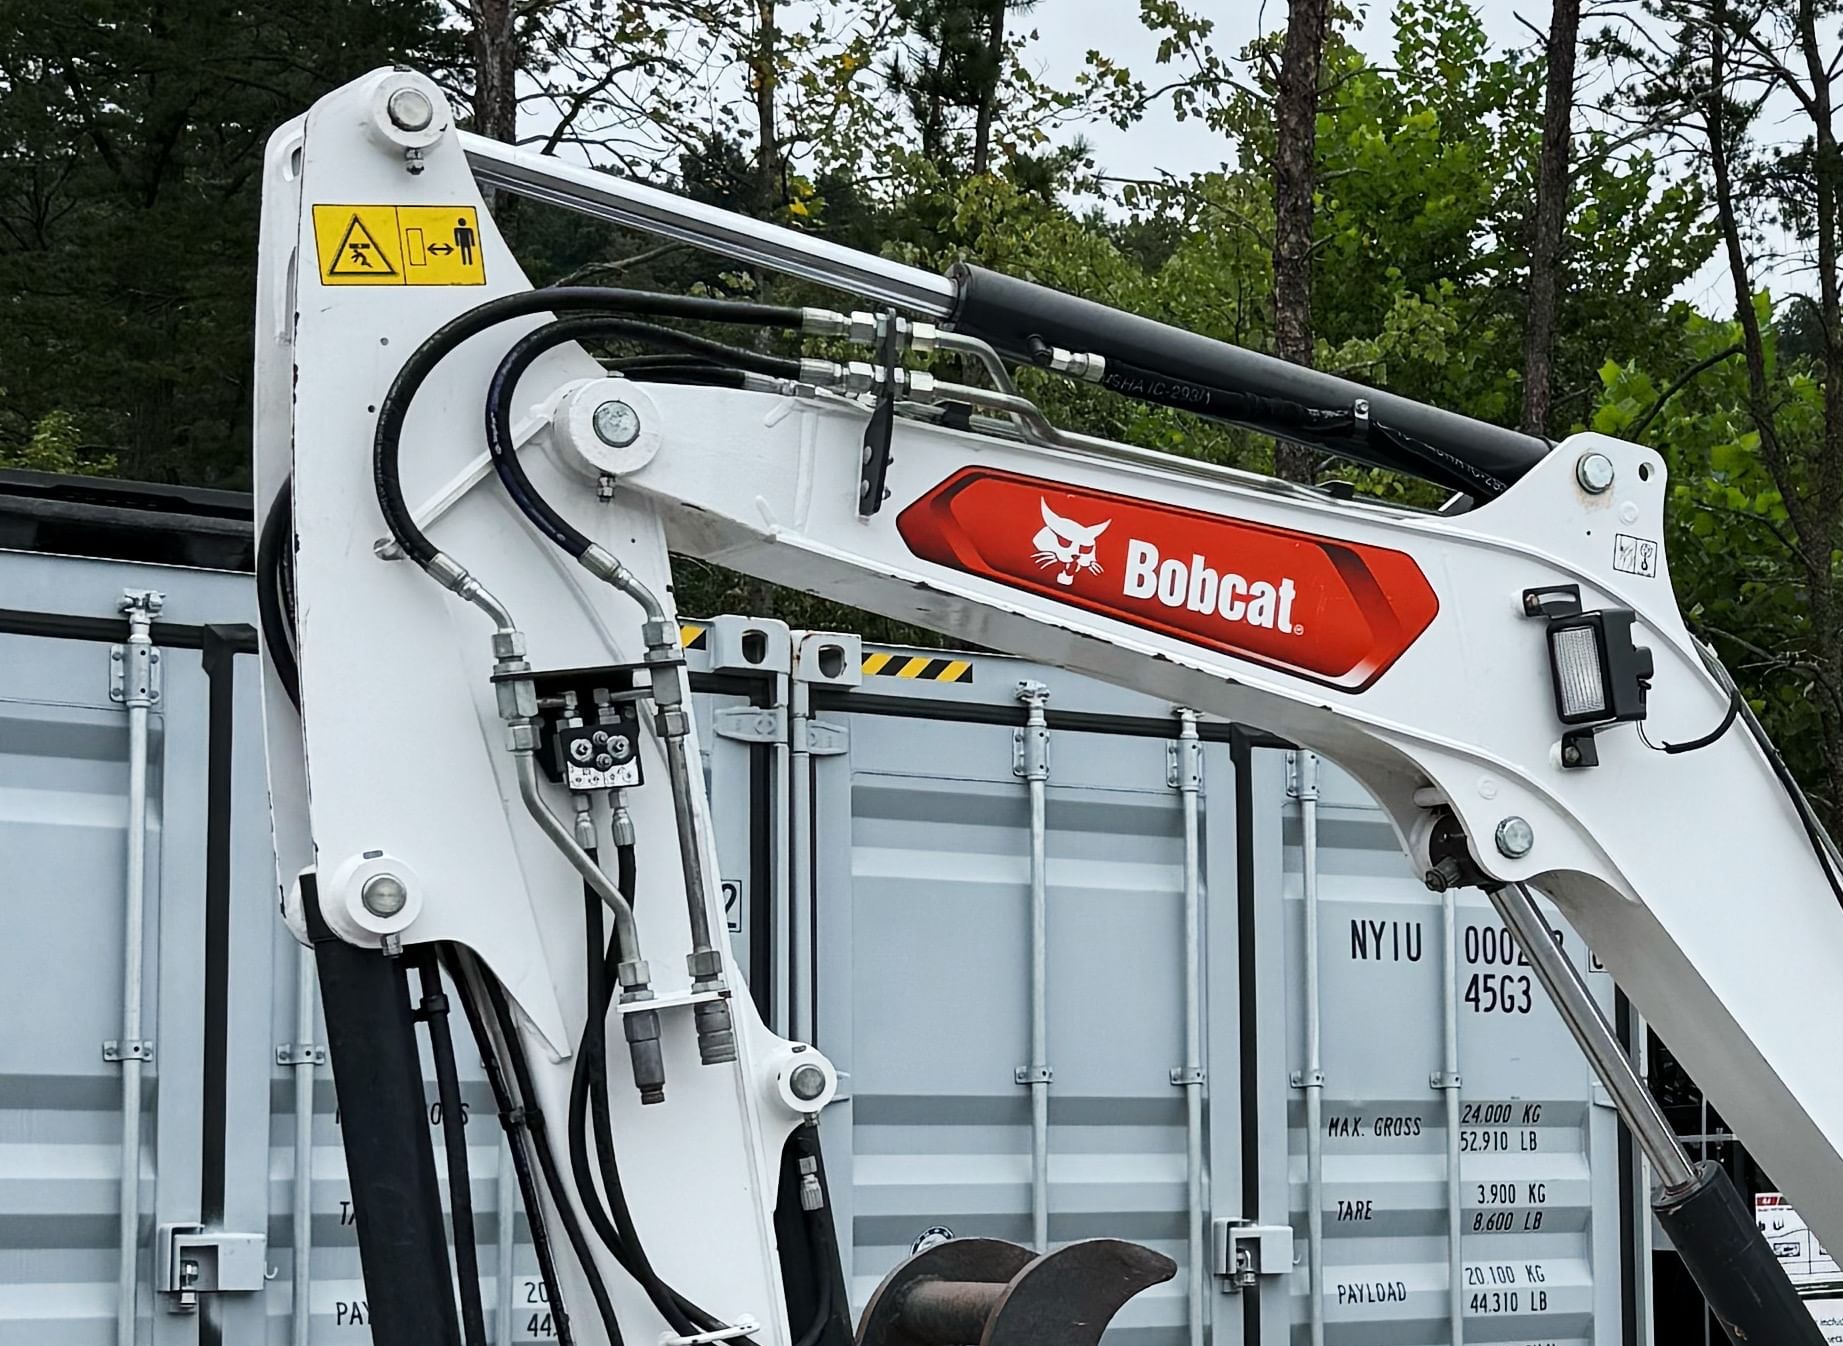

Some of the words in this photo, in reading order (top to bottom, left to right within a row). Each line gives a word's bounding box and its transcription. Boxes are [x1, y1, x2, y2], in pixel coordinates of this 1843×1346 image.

[1123, 538, 1297, 634] Bobcat
[1350, 919, 1421, 962] NYIU
[1464, 973, 1532, 1014] 45G3
[1461, 1104, 1512, 1124] 24.000
[1522, 1104, 1542, 1123] KG
[1328, 1117, 1365, 1137] MAX.
[1374, 1117, 1422, 1137] GROSS
[1460, 1131, 1508, 1152] 52.910
[1520, 1131, 1537, 1151] LB
[1477, 1184, 1516, 1204] 3.900
[1528, 1184, 1546, 1203] KG
[1337, 1200, 1373, 1221] TARE
[1473, 1212, 1514, 1231] 8.600
[1523, 1211, 1543, 1230] LB
[1465, 1266, 1515, 1285] 20.100
[1525, 1265, 1545, 1283] KG
[1337, 1282, 1407, 1304] PAYLOAD
[1470, 1292, 1518, 1313] 44.310
[1530, 1291, 1548, 1311] LB
